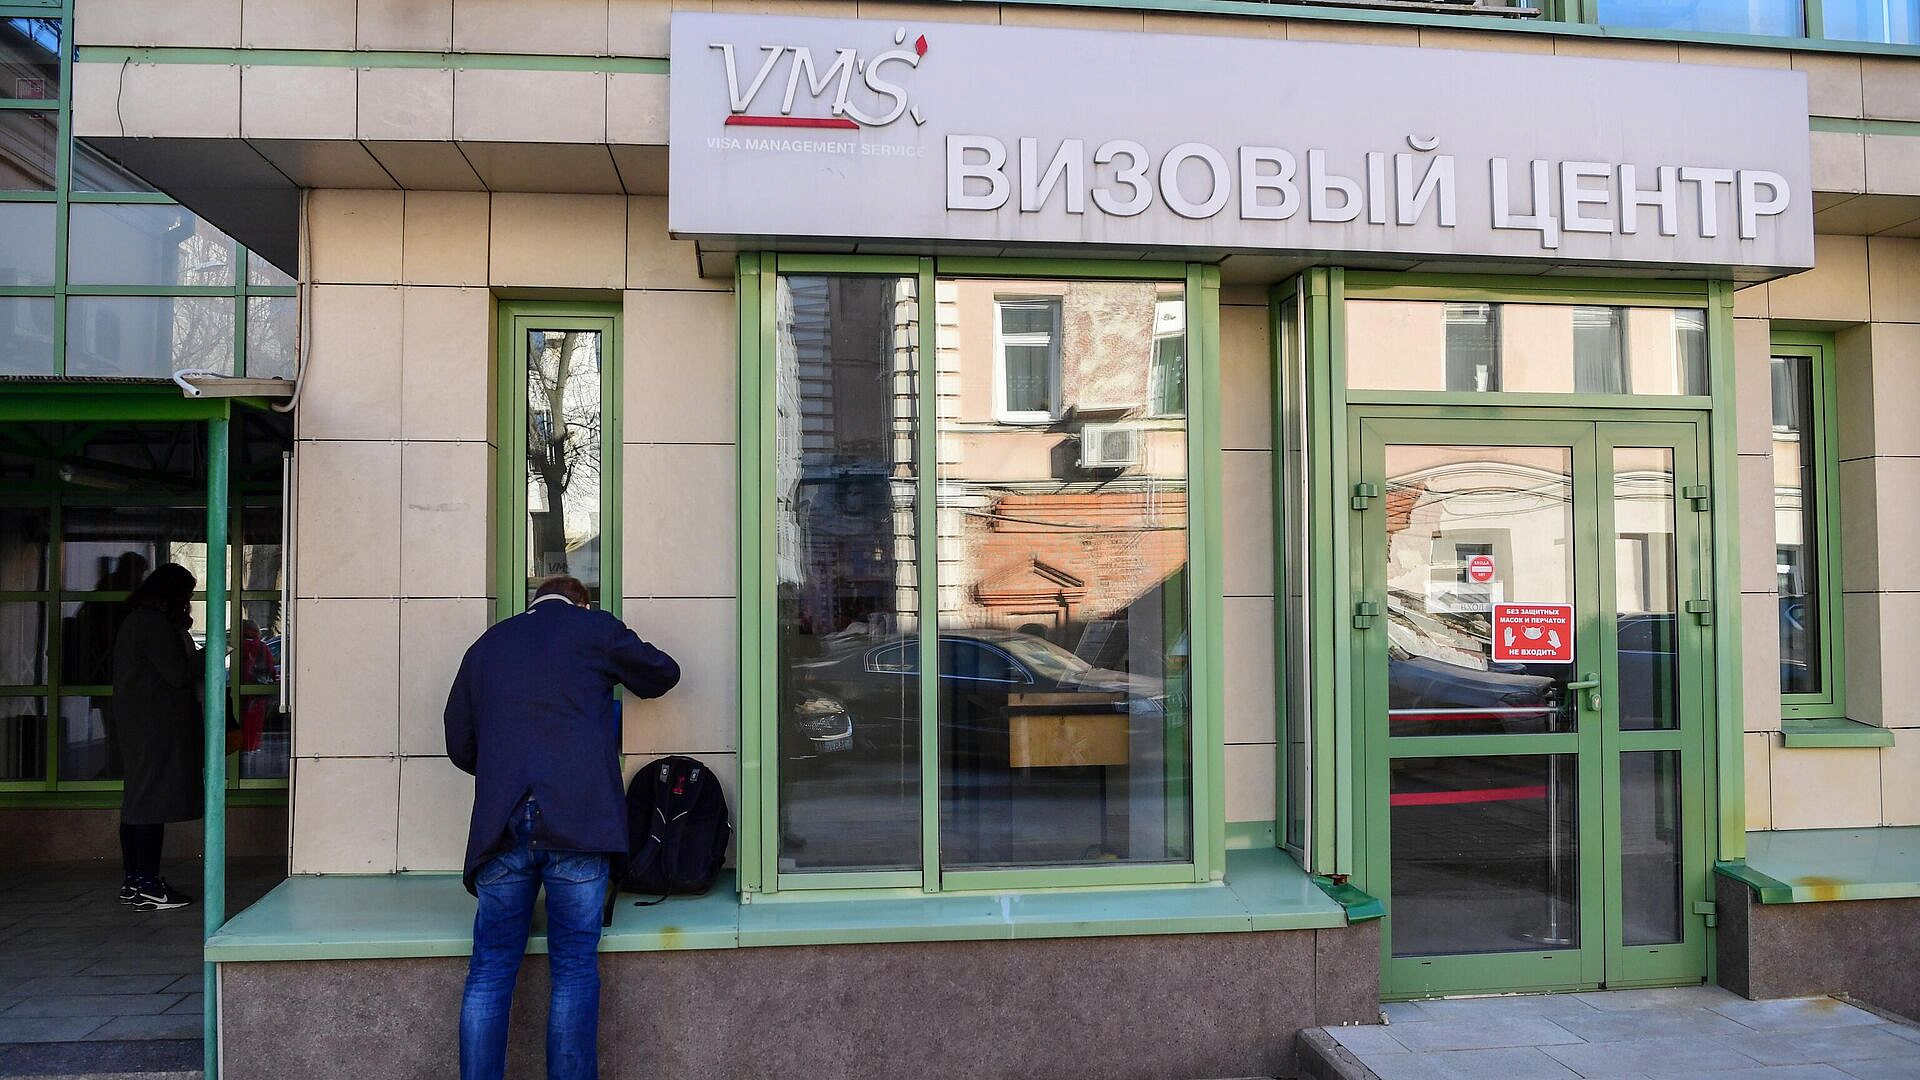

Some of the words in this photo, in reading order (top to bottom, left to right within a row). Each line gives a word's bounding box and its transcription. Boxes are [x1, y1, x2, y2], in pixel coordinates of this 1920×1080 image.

[706, 137, 740, 150] VISA
[745, 139, 857, 154] MANAGEMENT
[860, 143, 926, 158] SERVICE
[946, 133, 1456, 228] ВИЗОВЫЙ
[1490, 156, 1791, 250] ЦЕНТР
[1520, 608, 1560, 616] ЗАЩИТНЫХ
[1509, 648, 1519, 656] НЕ
[1521, 648, 1557, 657] ВХОДИТЬ
